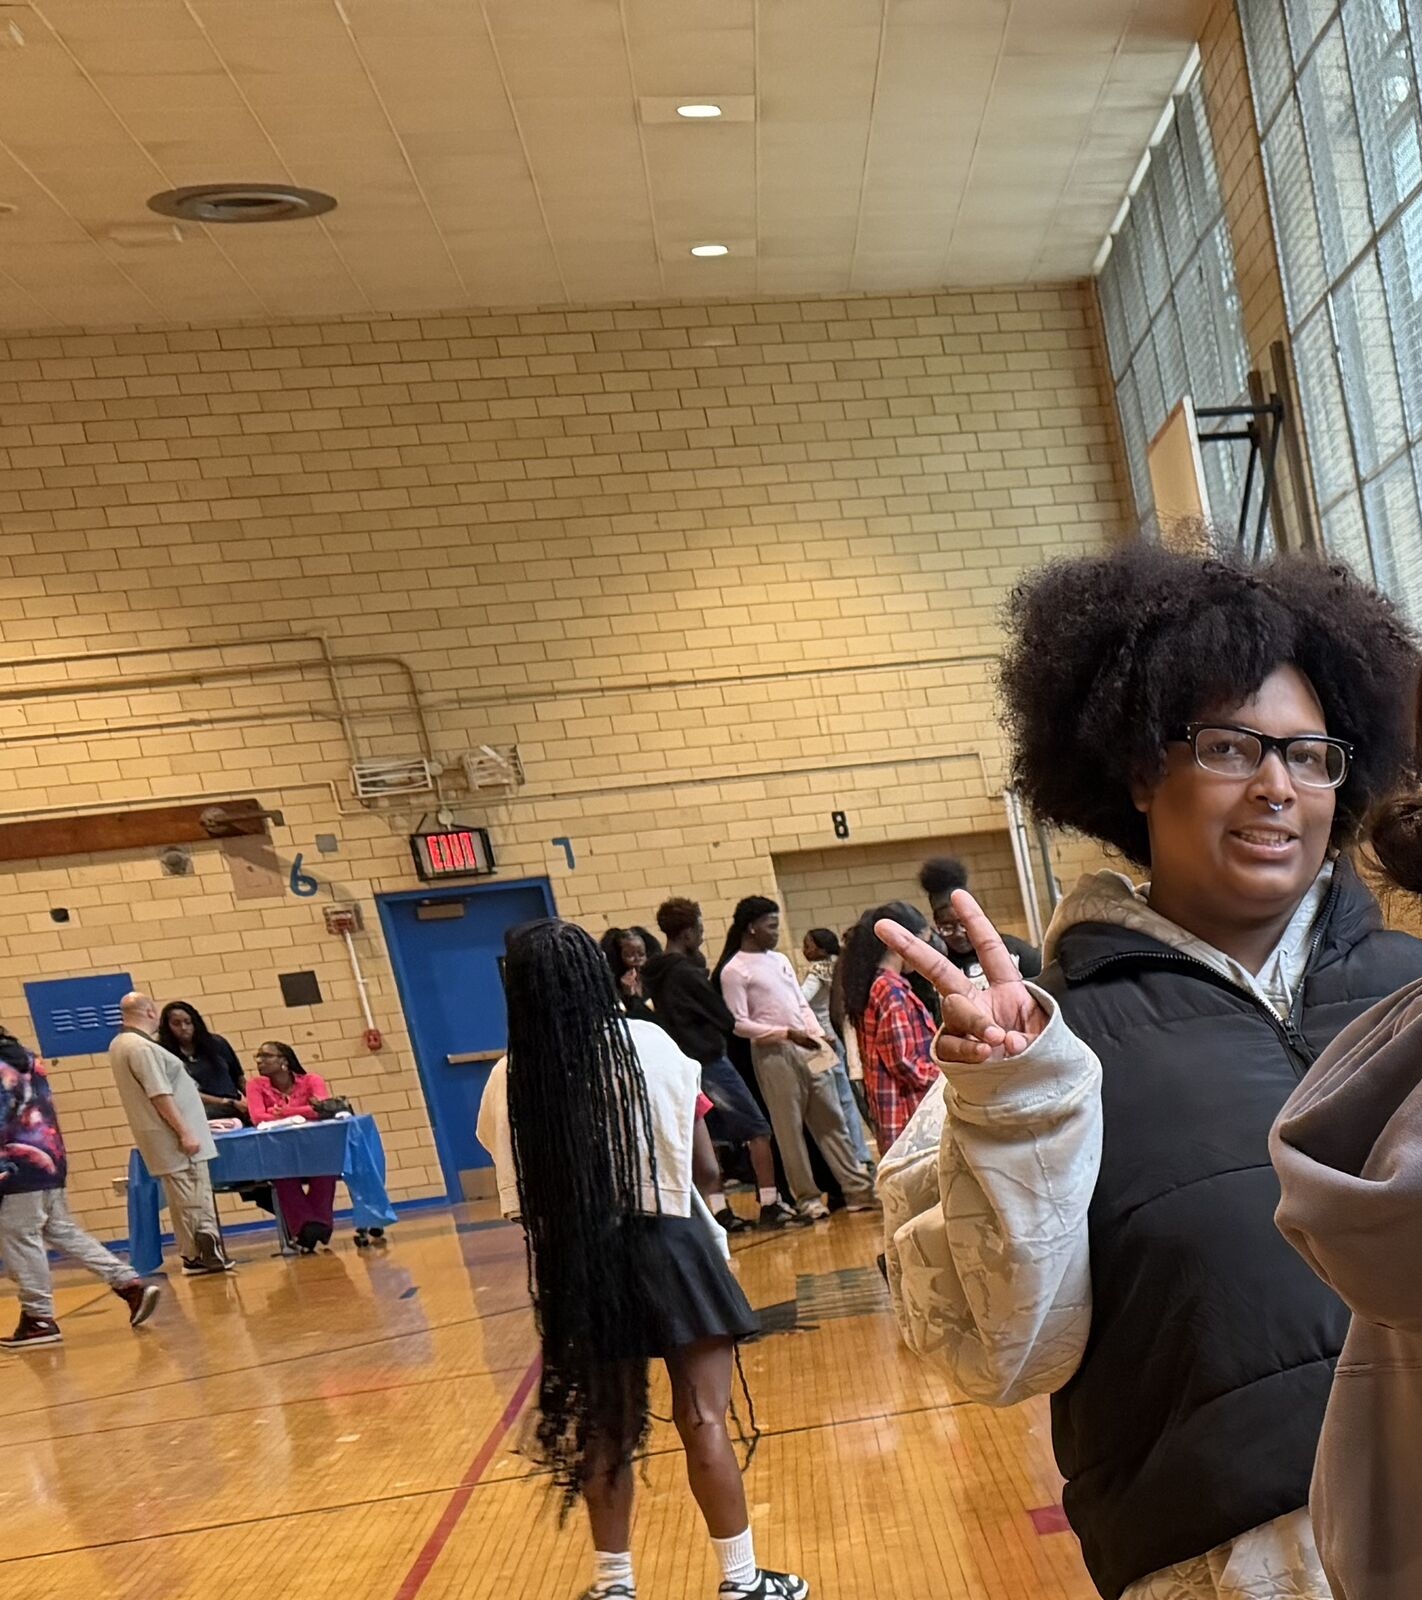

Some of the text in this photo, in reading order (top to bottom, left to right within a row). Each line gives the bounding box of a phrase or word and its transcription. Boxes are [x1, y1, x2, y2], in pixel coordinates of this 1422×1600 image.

[832, 811, 849, 839] 8
[427, 832, 476, 872] EXIT
[552, 837, 575, 870] 7
[290, 852, 318, 898] 6
